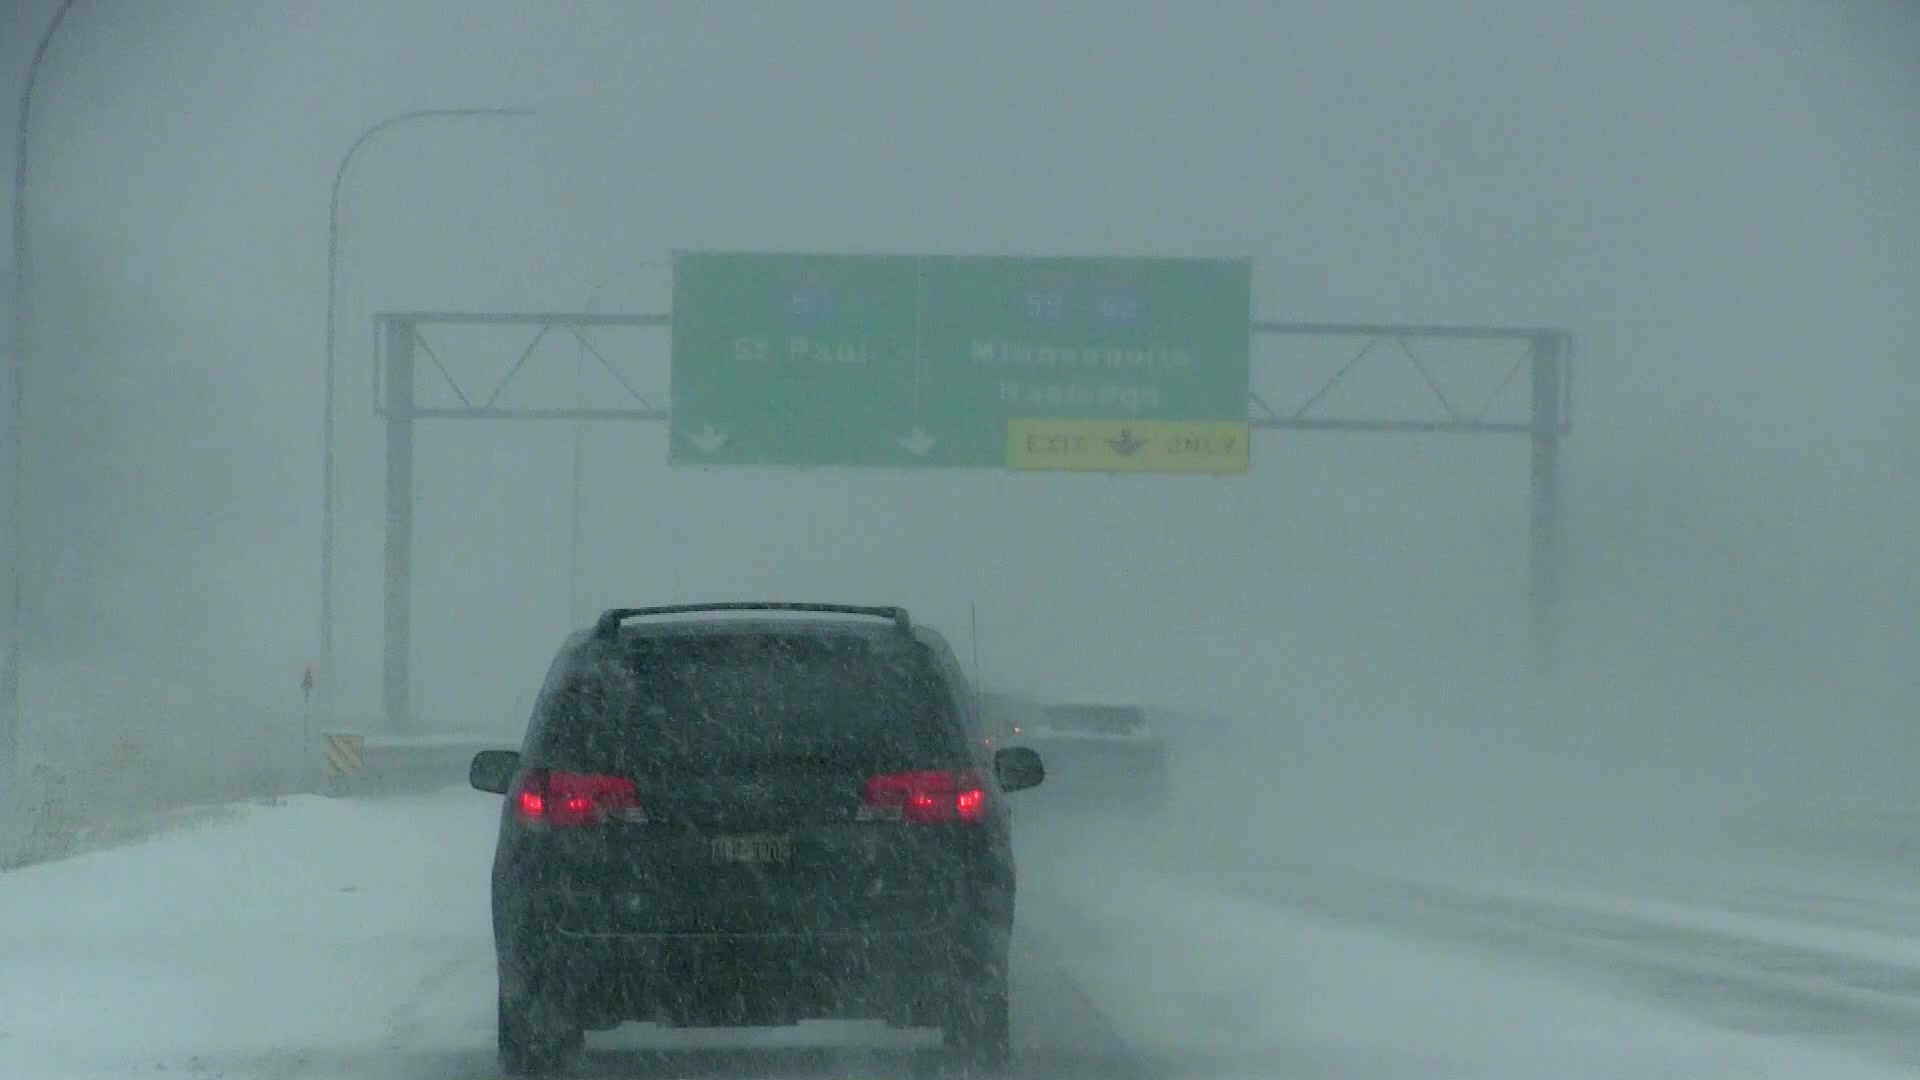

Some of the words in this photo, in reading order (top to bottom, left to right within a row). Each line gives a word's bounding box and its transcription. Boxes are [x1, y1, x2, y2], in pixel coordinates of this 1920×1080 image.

[788, 334, 867, 365] Paul
[1026, 434, 1087, 454] EXIT
[1166, 435, 1237, 456] ONLY
